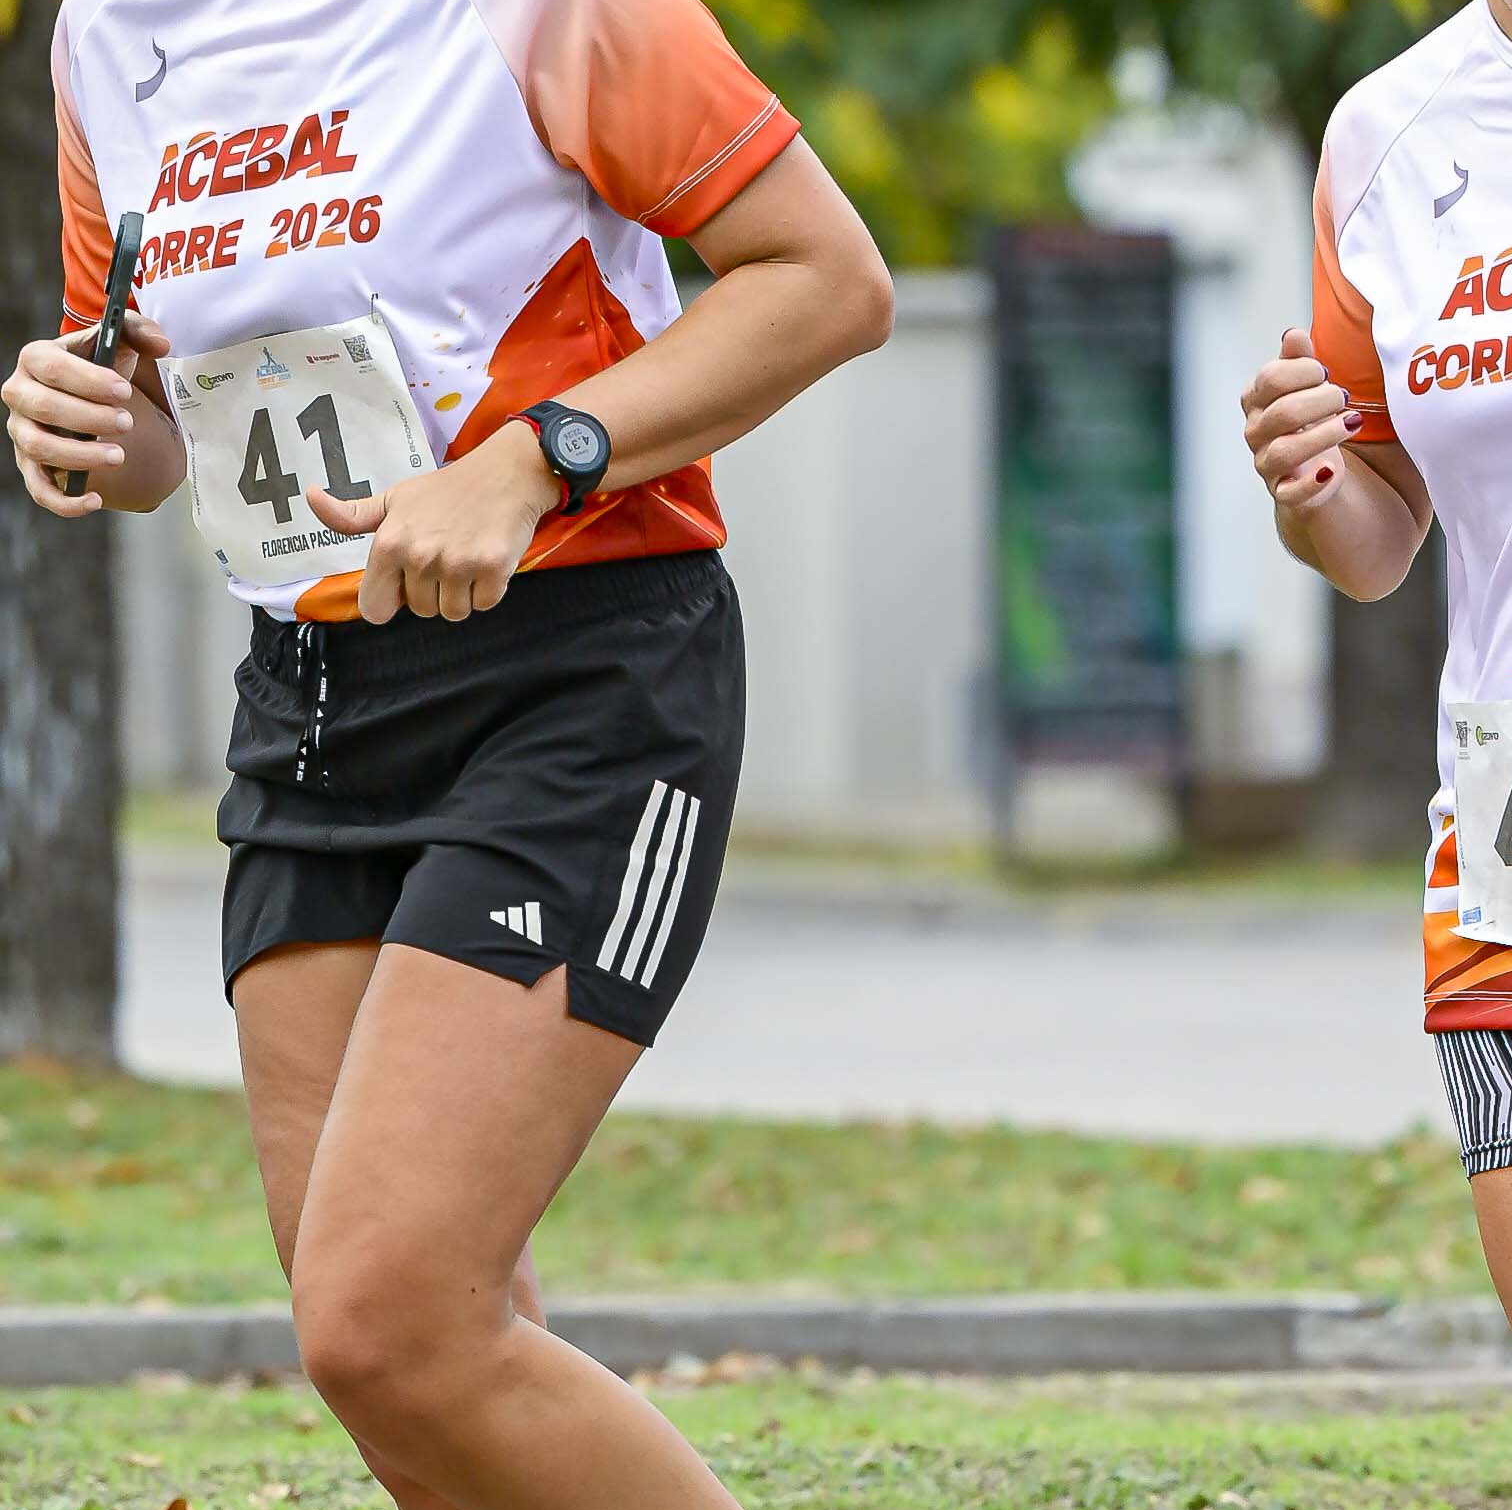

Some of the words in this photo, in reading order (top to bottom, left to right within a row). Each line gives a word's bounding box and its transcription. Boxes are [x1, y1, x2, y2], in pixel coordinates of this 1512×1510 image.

[147, 110, 358, 213] ACEBAL
[264, 195, 383, 259] 2026
[237, 394, 373, 525] 41
[261, 533, 310, 559] FLORENCIA
[309, 529, 366, 550] PASQU
